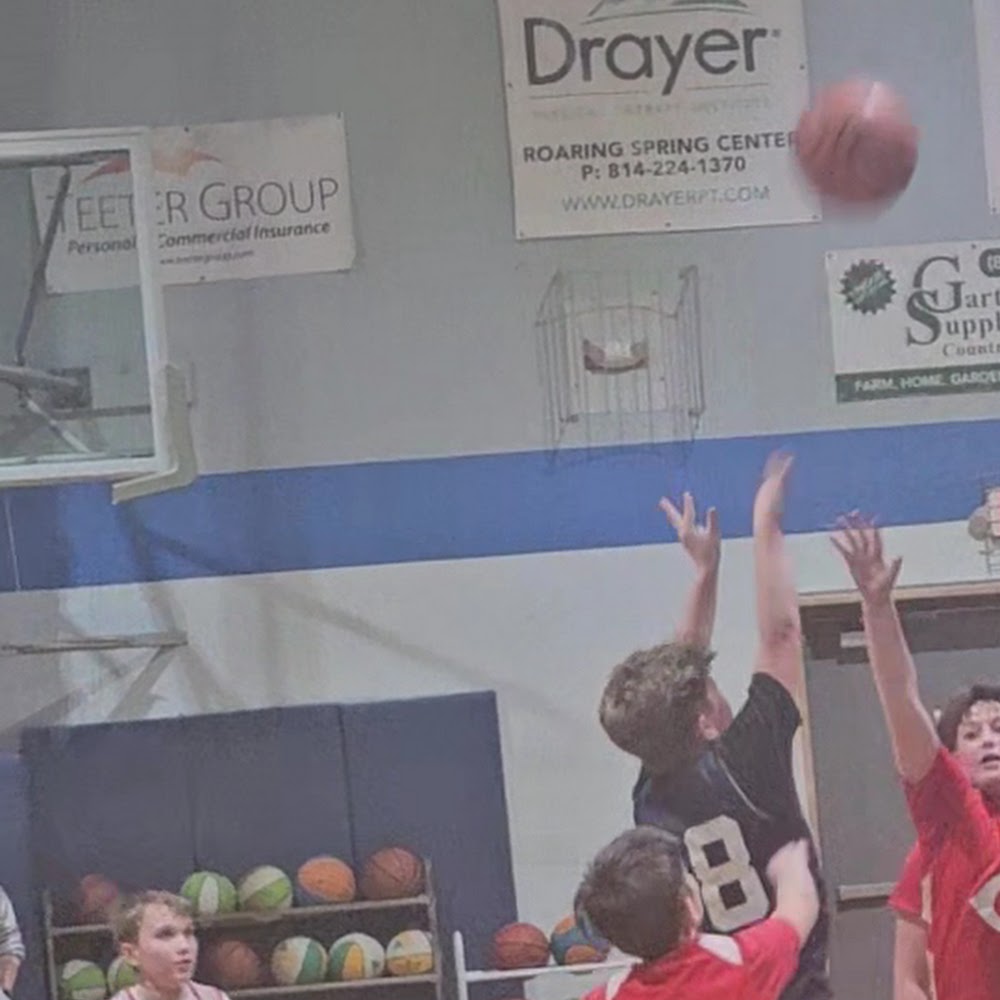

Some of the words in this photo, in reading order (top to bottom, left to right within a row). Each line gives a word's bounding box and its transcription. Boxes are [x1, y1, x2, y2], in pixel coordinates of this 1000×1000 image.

[523, 17, 768, 96] Drayer
[523, 143, 624, 163] ROARING
[631, 137, 710, 157] SPRING
[581, 164, 600, 180] P:
[608, 156, 746, 179] 814-224-1370
[200, 177, 339, 222] GROUP
[562, 185, 770, 212] WWW.DRAYERPT.COM
[67, 235, 138, 255] Personal
[253, 220, 331, 239] Insurance
[684, 814, 770, 934] 8
